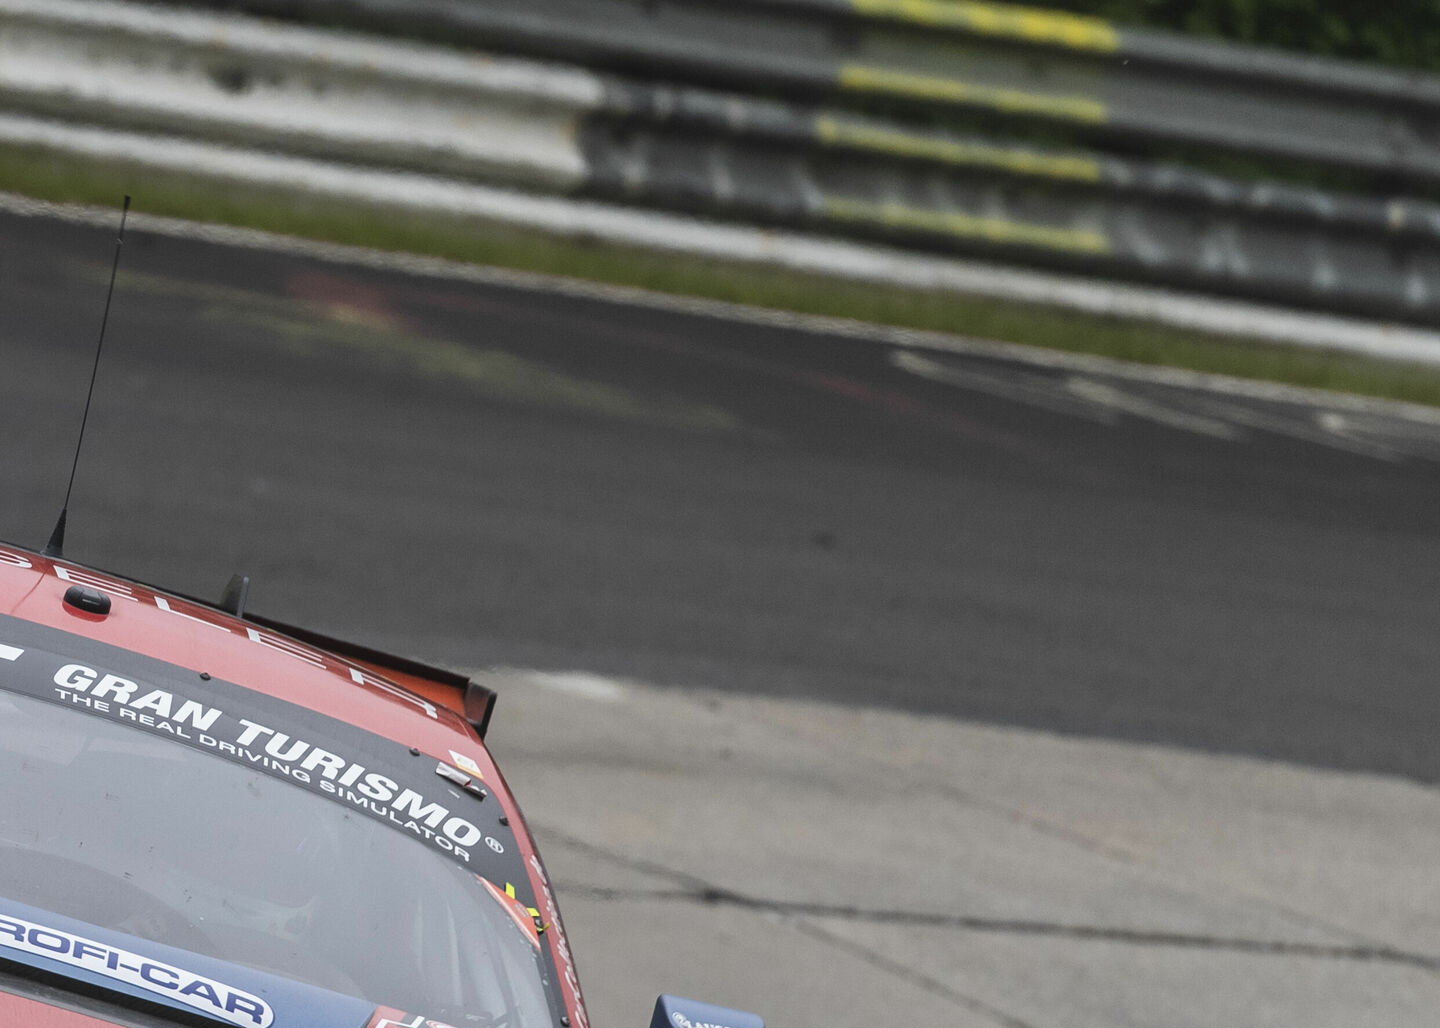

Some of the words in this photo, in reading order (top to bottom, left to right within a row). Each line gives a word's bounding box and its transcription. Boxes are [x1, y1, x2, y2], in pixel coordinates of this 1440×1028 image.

[53, 663, 223, 731] GRAN
[54, 687, 110, 713] THE
[119, 707, 191, 739] REAL
[199, 733, 311, 784] DRIVING
[319, 779, 470, 862] SIMULATOR
